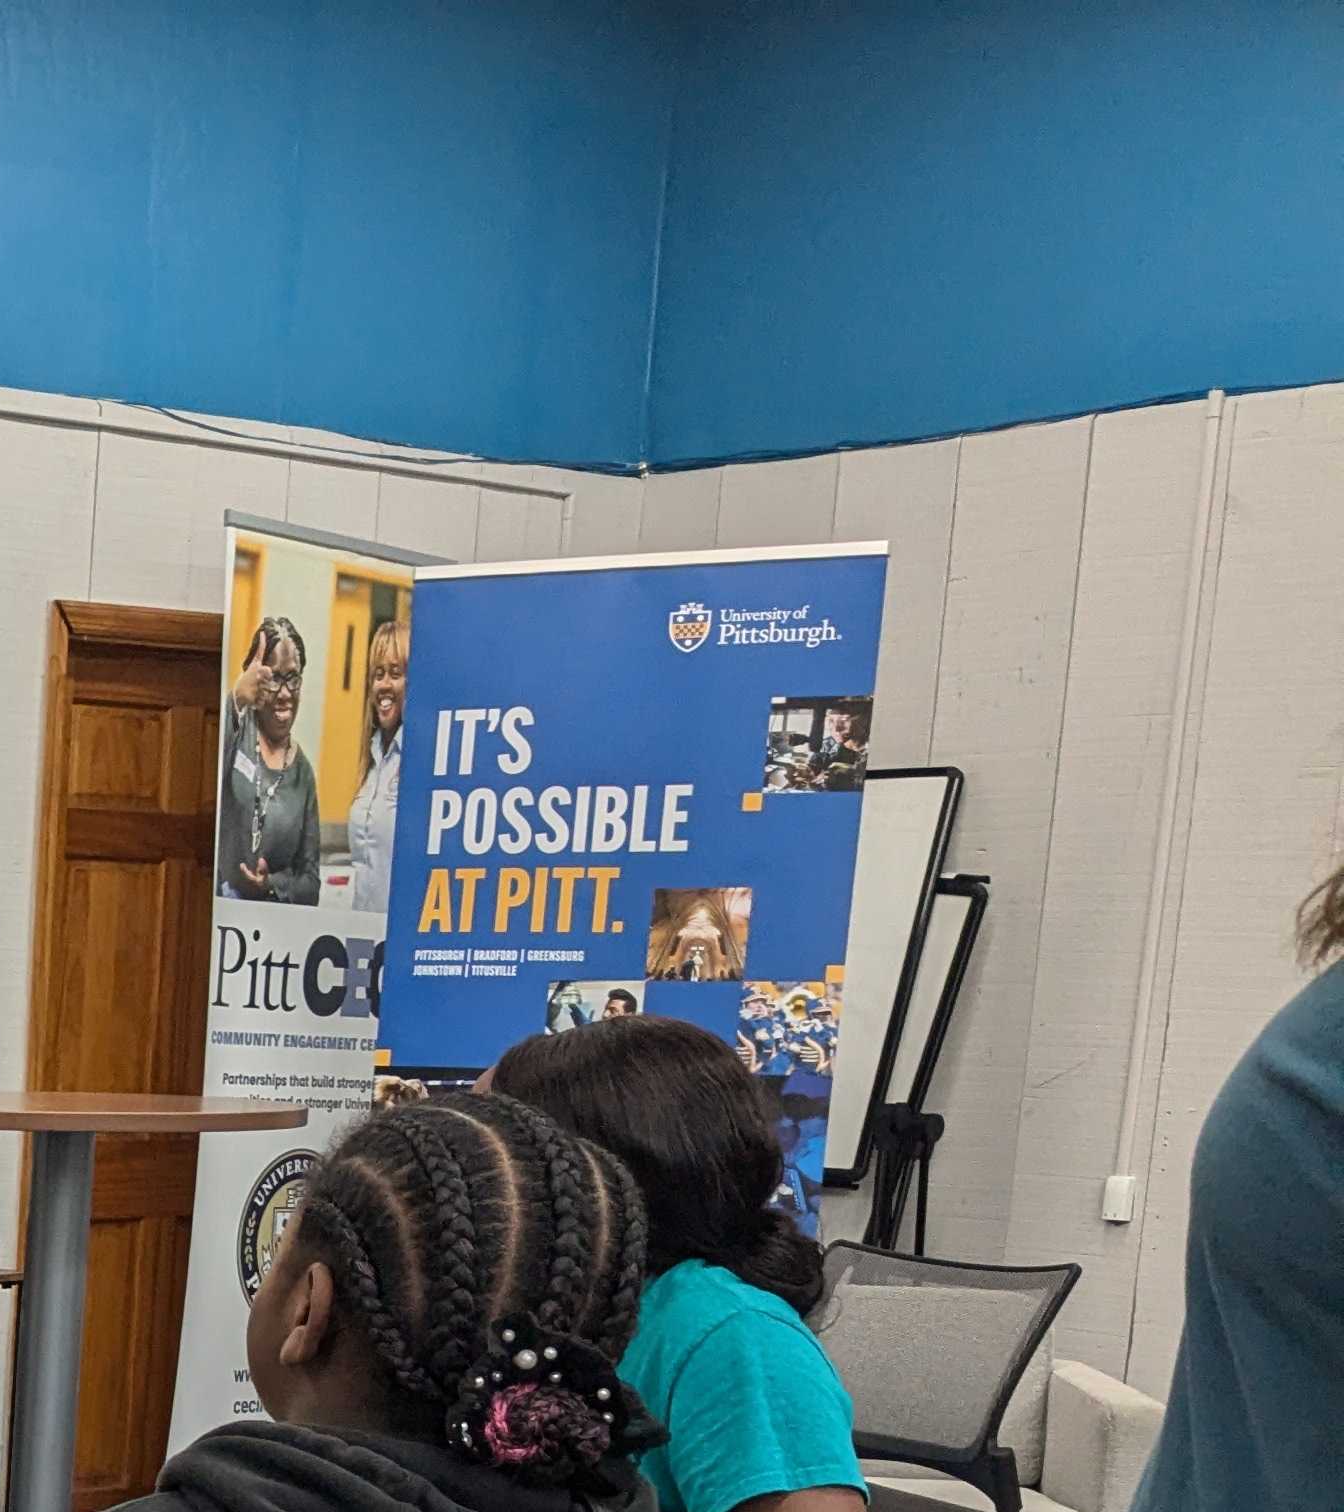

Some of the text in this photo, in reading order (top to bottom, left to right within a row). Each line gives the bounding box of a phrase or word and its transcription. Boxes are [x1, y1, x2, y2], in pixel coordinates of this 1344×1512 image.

[720, 605, 810, 624] University of
[433, 706, 535, 776] IT'S
[426, 784, 694, 855] POSSIBLE
[417, 867, 624, 934] AT PITT.
[414, 949, 585, 962] PITTSBURGH BRADFORD GREENSBURG
[413, 965, 518, 977] JOHNSTOWN TITUSVILLE
[211, 1031, 377, 1052] COMMUNITY ENGAGEMENT CE
[222, 1073, 374, 1093] Partnerships that build stronge
[304, 1098, 342, 1113] stronger
[344, 1097, 371, 1111] Unive
[254, 1158, 314, 1207] UNIVERS
